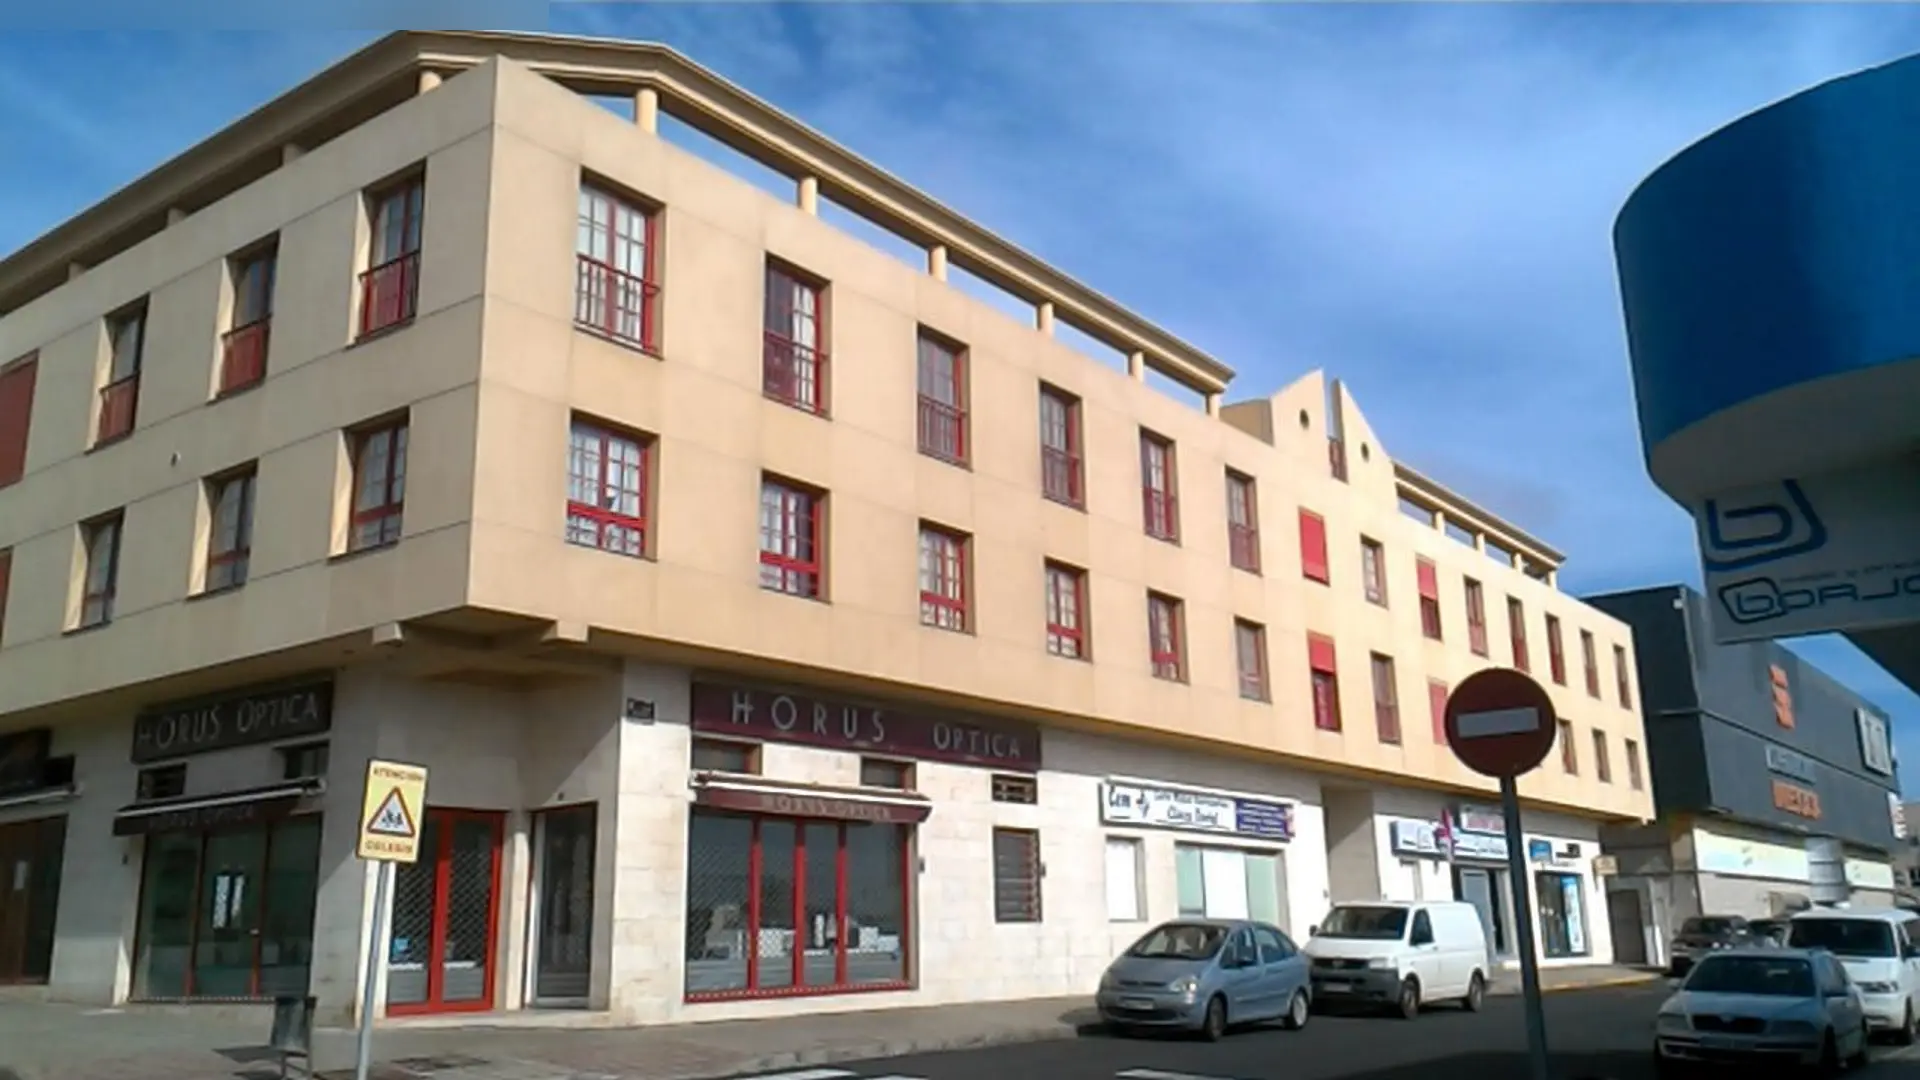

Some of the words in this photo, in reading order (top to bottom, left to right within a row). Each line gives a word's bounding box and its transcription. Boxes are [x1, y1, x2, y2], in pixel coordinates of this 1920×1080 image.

[137, 704, 221, 749] HORUS
[236, 691, 319, 733] OPTICA
[731, 691, 885, 743] HORUS
[933, 721, 1022, 758] OPTICA
